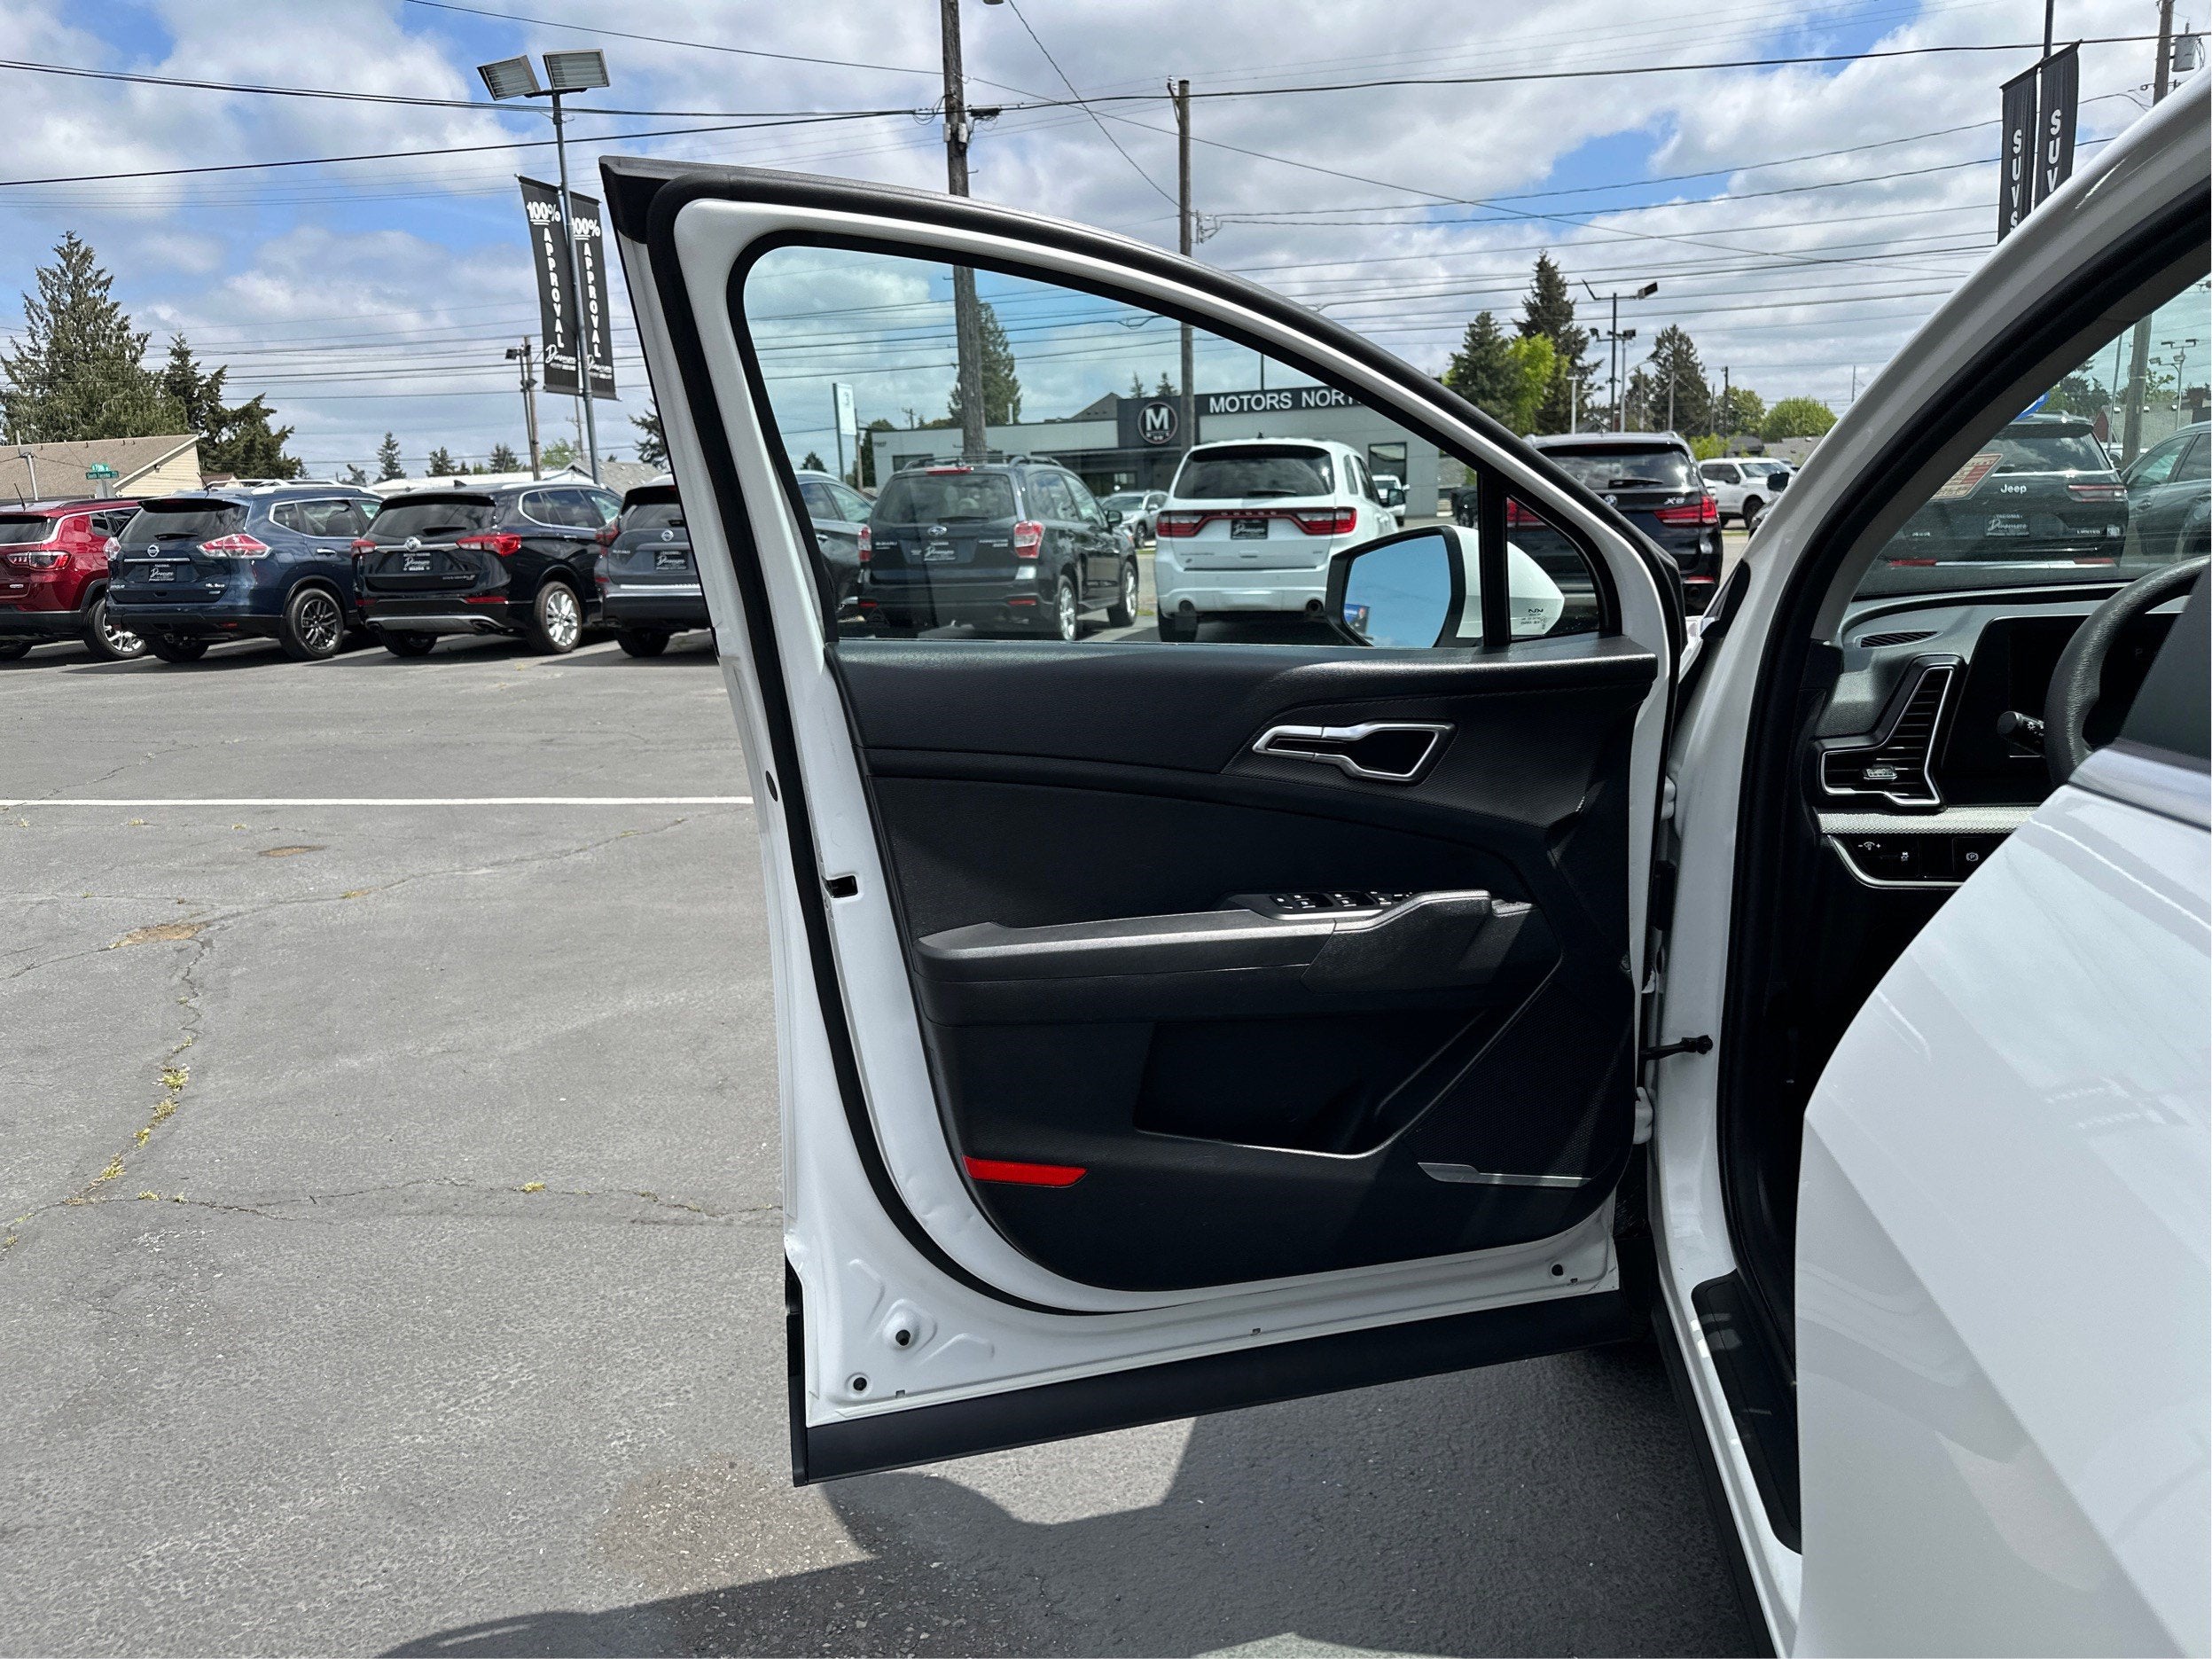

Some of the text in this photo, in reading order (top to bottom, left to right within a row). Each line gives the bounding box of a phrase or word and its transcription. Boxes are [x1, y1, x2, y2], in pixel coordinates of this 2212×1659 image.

[527, 201, 561, 223] 100%
[543, 227, 565, 348] APPROVAL
[583, 242, 602, 358] APPROVAL
[1208, 389, 1362, 414] MOTORS NOR
[1145, 407, 1169, 431] M
[2000, 483, 2028, 494] Jeep
